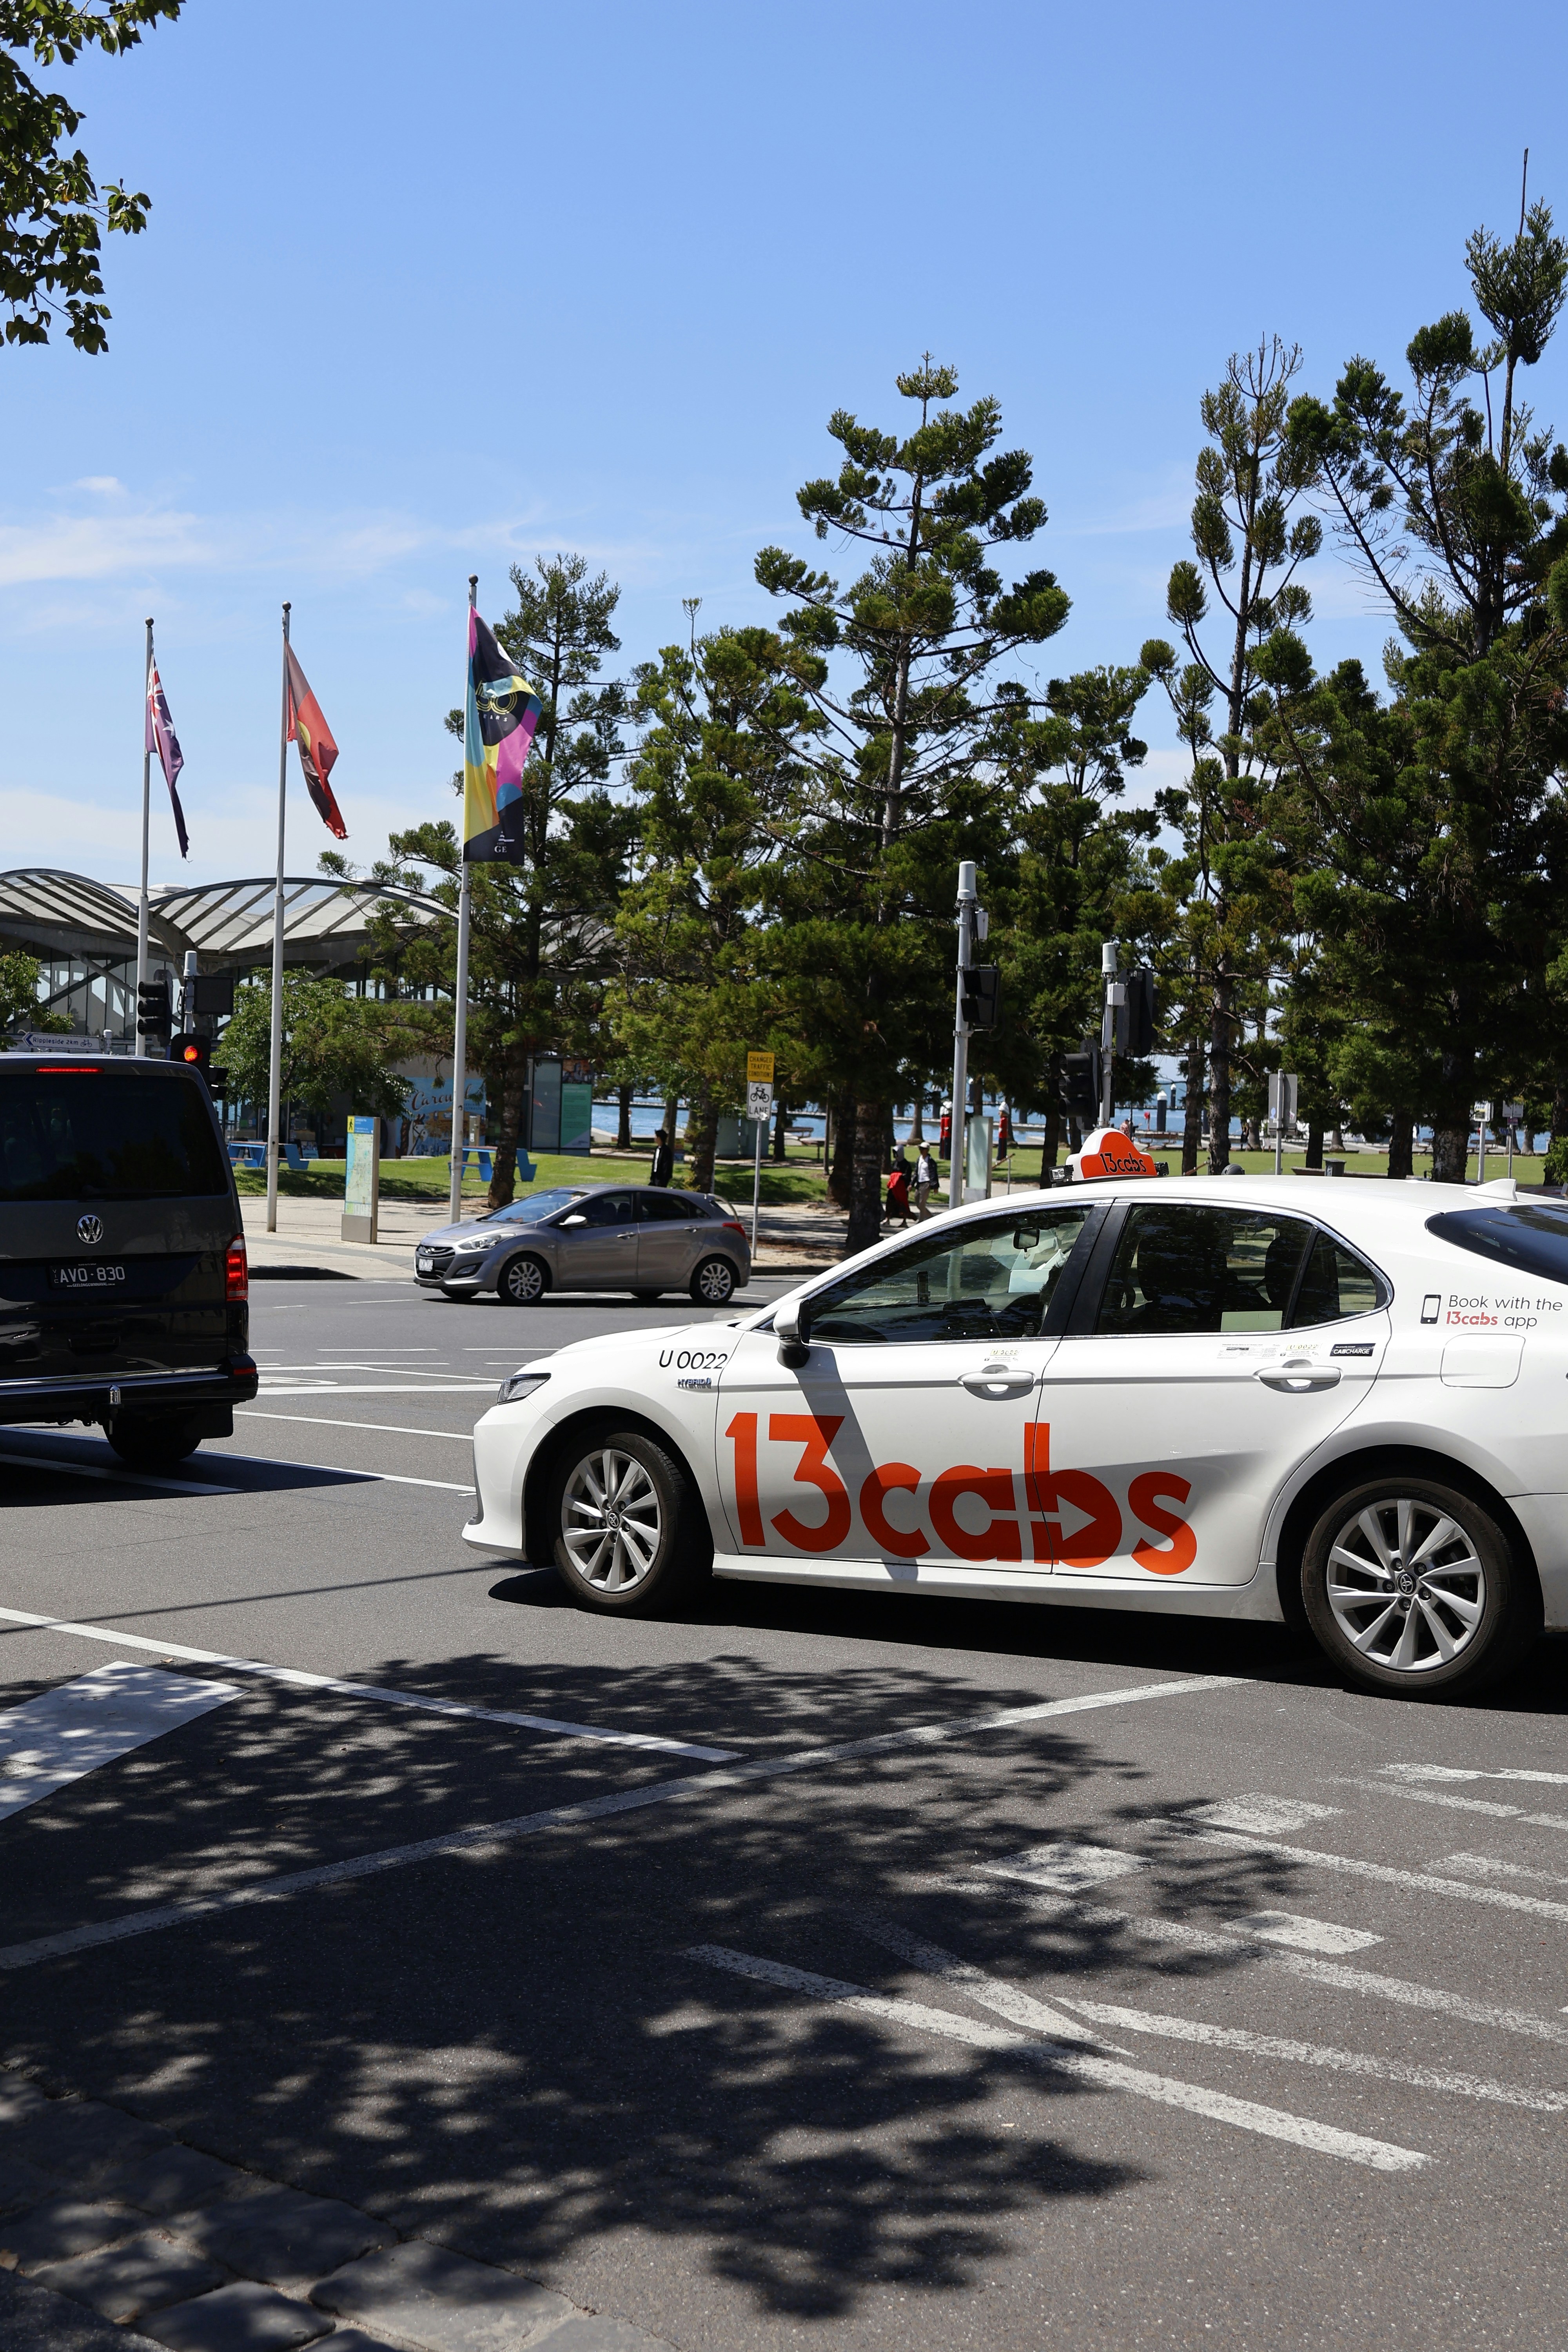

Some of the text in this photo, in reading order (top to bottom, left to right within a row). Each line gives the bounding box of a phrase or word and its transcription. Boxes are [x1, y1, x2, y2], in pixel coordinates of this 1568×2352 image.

[477, 713, 508, 722] EARS
[1100, 1152, 1147, 1173] 13cabs
[96, 1266, 125, 1281] 830
[1449, 1295, 1563, 1311] Book with the
[1446, 1311, 1538, 1330] 13cabs app
[659, 1350, 728, 1370] U 0022
[725, 1412, 1197, 1575] 13cabs
